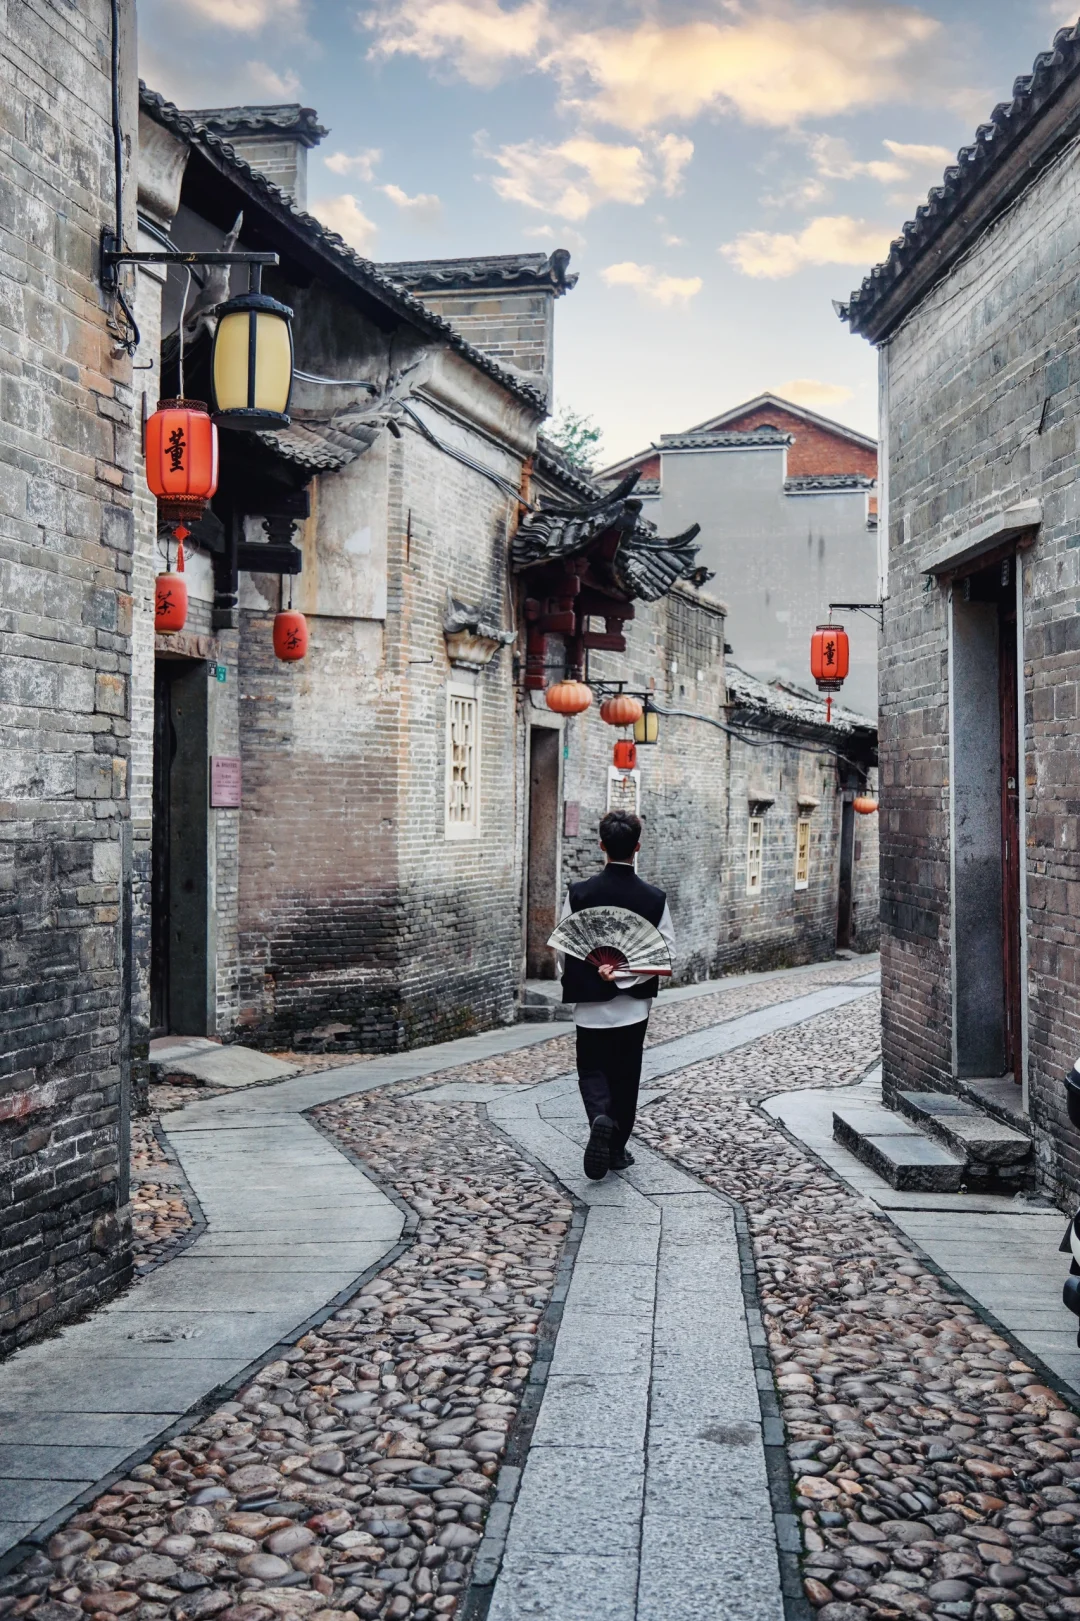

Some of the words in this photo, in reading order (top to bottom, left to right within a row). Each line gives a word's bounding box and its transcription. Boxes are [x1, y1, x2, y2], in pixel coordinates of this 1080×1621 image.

[164, 427, 187, 473] 董
[285, 627, 303, 651] 茶
[823, 640, 836, 666] 董
